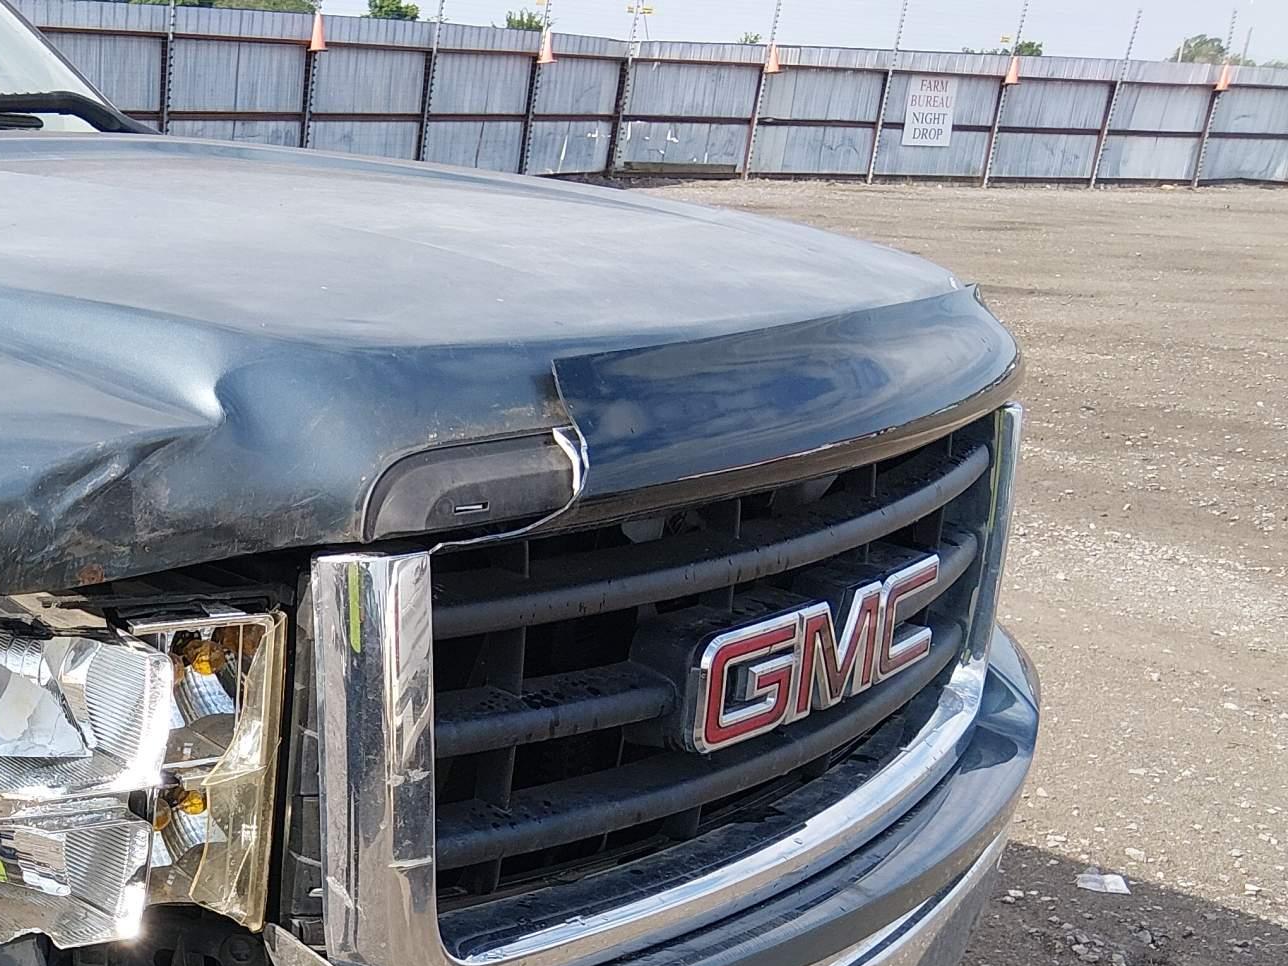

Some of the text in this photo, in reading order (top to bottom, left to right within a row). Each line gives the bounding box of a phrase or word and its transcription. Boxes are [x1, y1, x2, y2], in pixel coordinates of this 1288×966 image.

[920, 79, 949, 93] FARM
[910, 94, 953, 108] BUREAU
[911, 111, 948, 125] NIGHT
[912, 127, 943, 140] DROP
[693, 553, 941, 754] GMC
